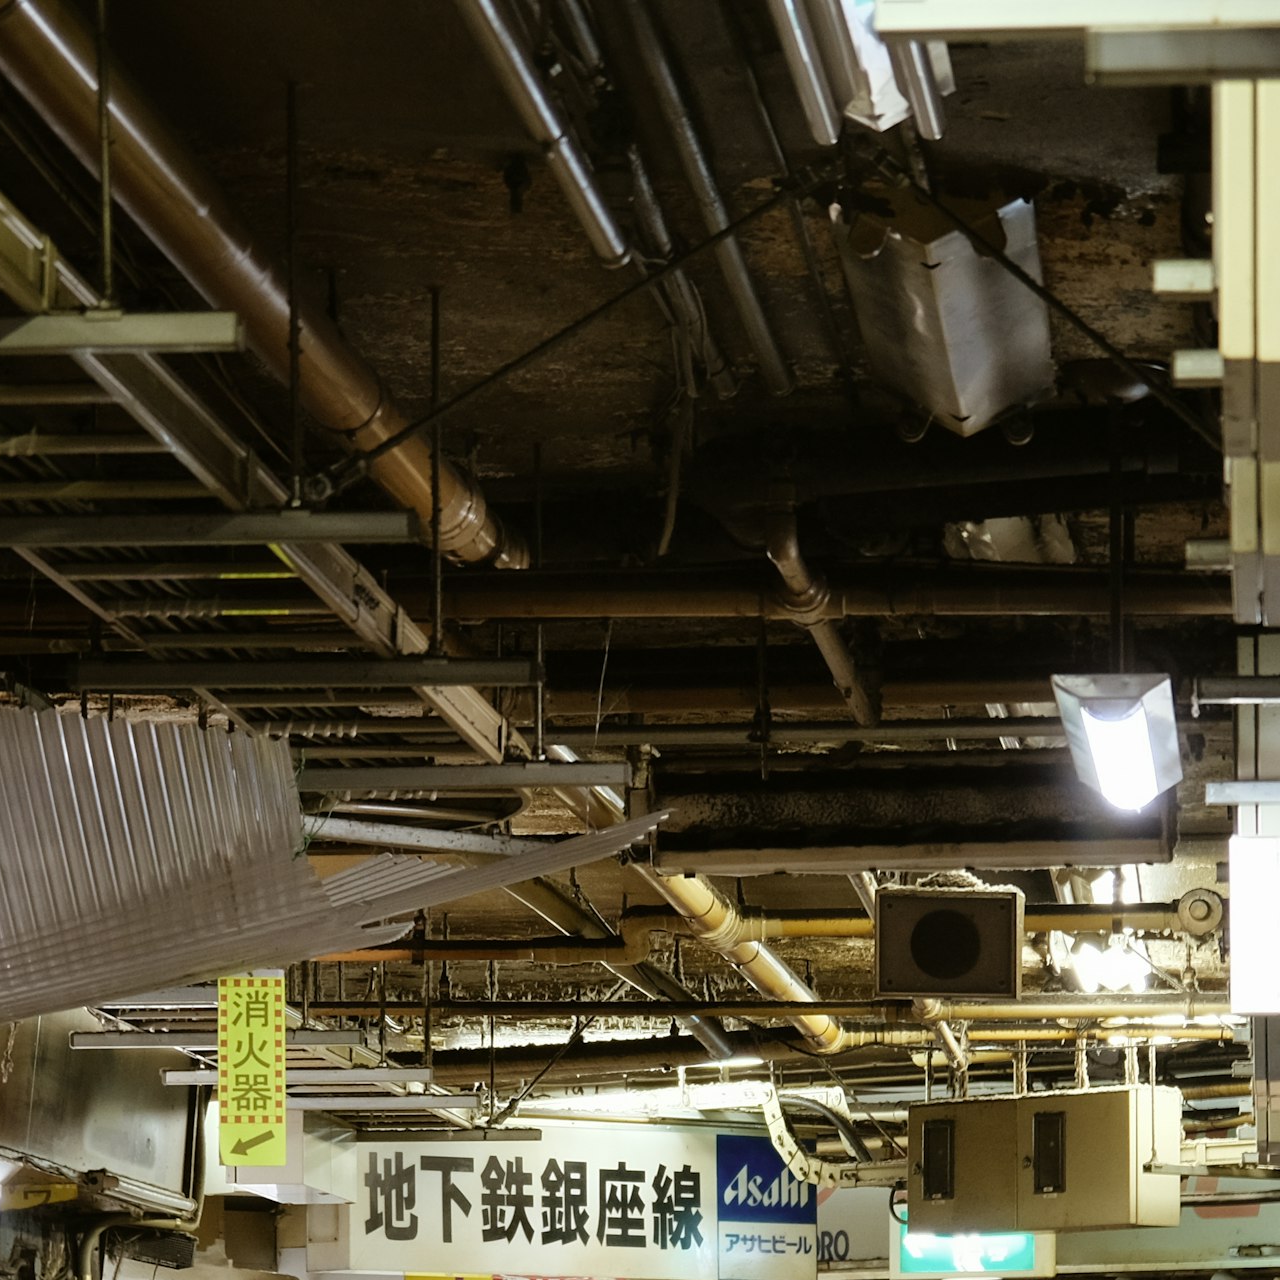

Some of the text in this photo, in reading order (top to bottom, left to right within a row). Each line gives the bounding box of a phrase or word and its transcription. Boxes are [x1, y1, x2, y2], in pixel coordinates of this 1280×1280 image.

[231, 990, 272, 1111] 消火器
[364, 1151, 704, 1250] 地下鉄銀座線
[723, 1163, 809, 1208] Asahi
[725, 1233, 812, 1255] アサヒビール
